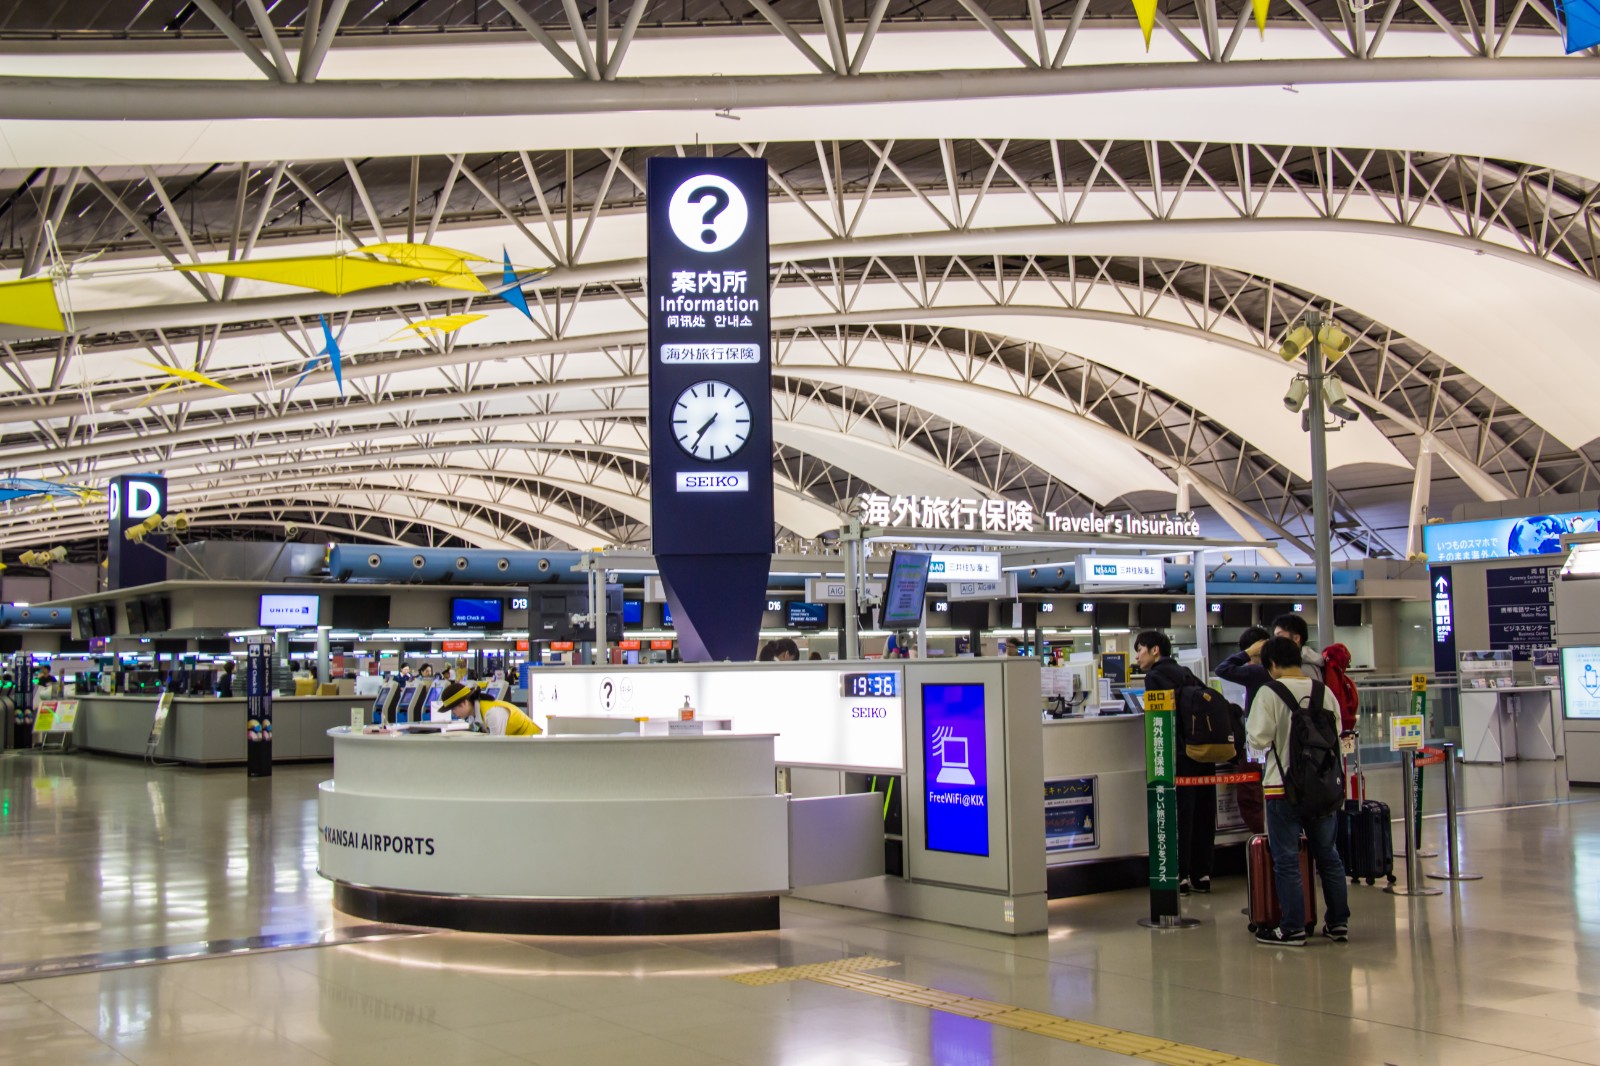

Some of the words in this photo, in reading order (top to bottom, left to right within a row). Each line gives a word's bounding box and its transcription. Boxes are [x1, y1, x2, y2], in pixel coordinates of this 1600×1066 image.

[671, 271, 747, 293] 案内所
[661, 296, 759, 311] Information
[667, 315, 706, 328] 问讯处
[714, 315, 752, 327] 안내소
[666, 347, 755, 360] 海外旅行保険
[685, 476, 739, 487] SEIKO
[128, 481, 161, 518] D
[860, 492, 1034, 532] 海外旅行保険
[1046, 512, 1122, 533] Traveler's
[1127, 514, 1200, 536] Insurance
[1437, 537, 1499, 551] いつものスマホで
[1095, 566, 1116, 575] MS&AD
[962, 585, 973, 593] AIG
[512, 599, 527, 609] D13
[768, 601, 781, 610] D16
[1043, 603, 1053, 612] D19
[853, 676, 892, 696] 19:36
[1147, 692, 1165, 702] 出口
[852, 707, 887, 718] SEIKO
[1150, 703, 1164, 711] EXIT
[1153, 717, 1165, 777] 海外旅行保険
[929, 791, 984, 807] FreeWiFi@KIX
[1156, 785, 1167, 882] 楽しい旅行に安心をプラス
[327, 827, 358, 849] KANSAI
[361, 833, 435, 855] AIRPORTS
